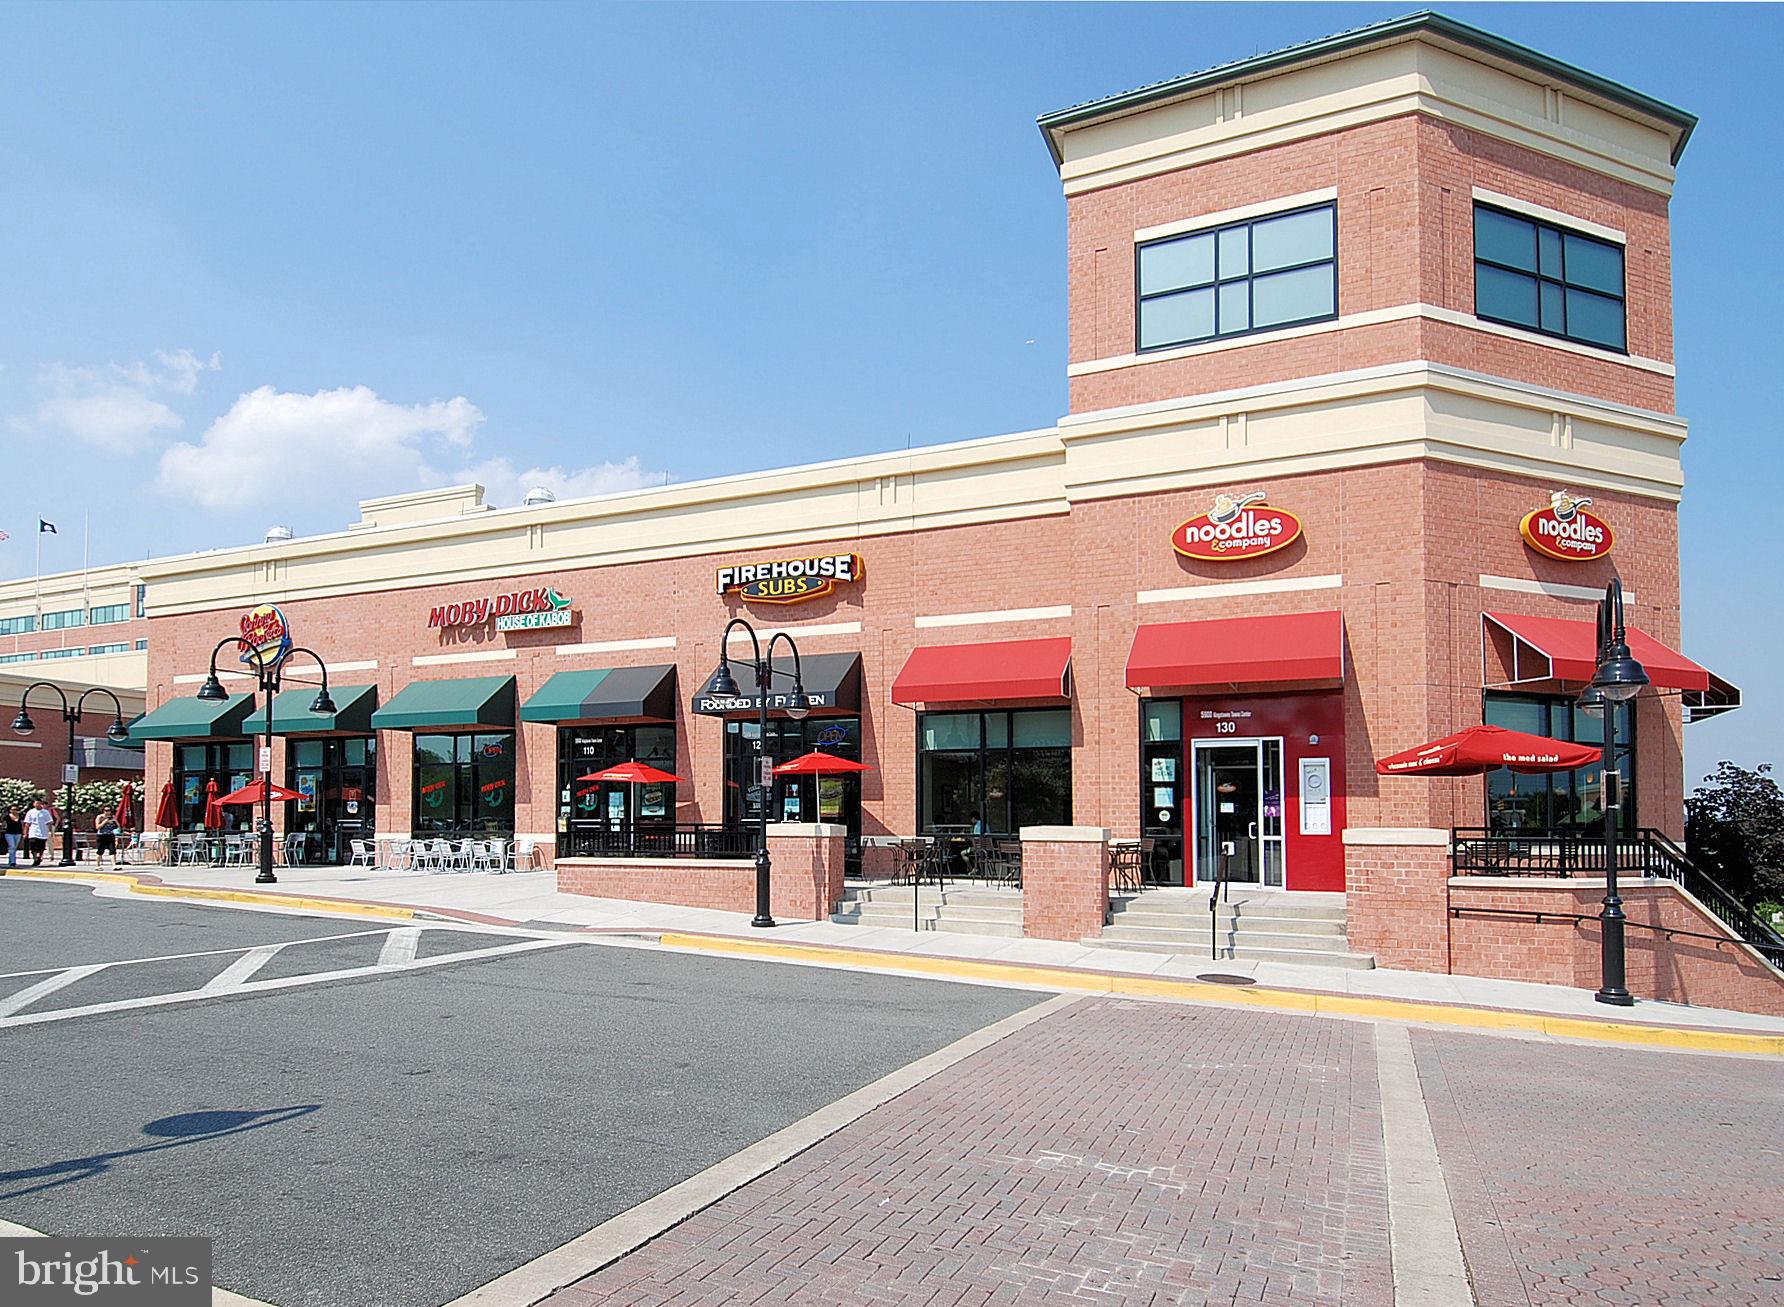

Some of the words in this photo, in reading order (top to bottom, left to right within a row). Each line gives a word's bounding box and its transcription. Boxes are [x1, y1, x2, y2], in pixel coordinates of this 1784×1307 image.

[1186, 511, 1282, 543] noodles
[1539, 514, 1603, 543] noodles
[717, 553, 852, 594] FIREHOUSE
[758, 577, 808, 596] SUBS
[427, 598, 489, 628] MOBY
[495, 587, 550, 616] DICK
[498, 615, 525, 631] HOUSE
[527, 614, 538, 627] OF
[540, 611, 571, 626] KABOB
[1215, 721, 1236, 733] 130
[583, 746, 595, 755] 110
[752, 741, 761, 749] 12
[1502, 752, 1517, 762] the
